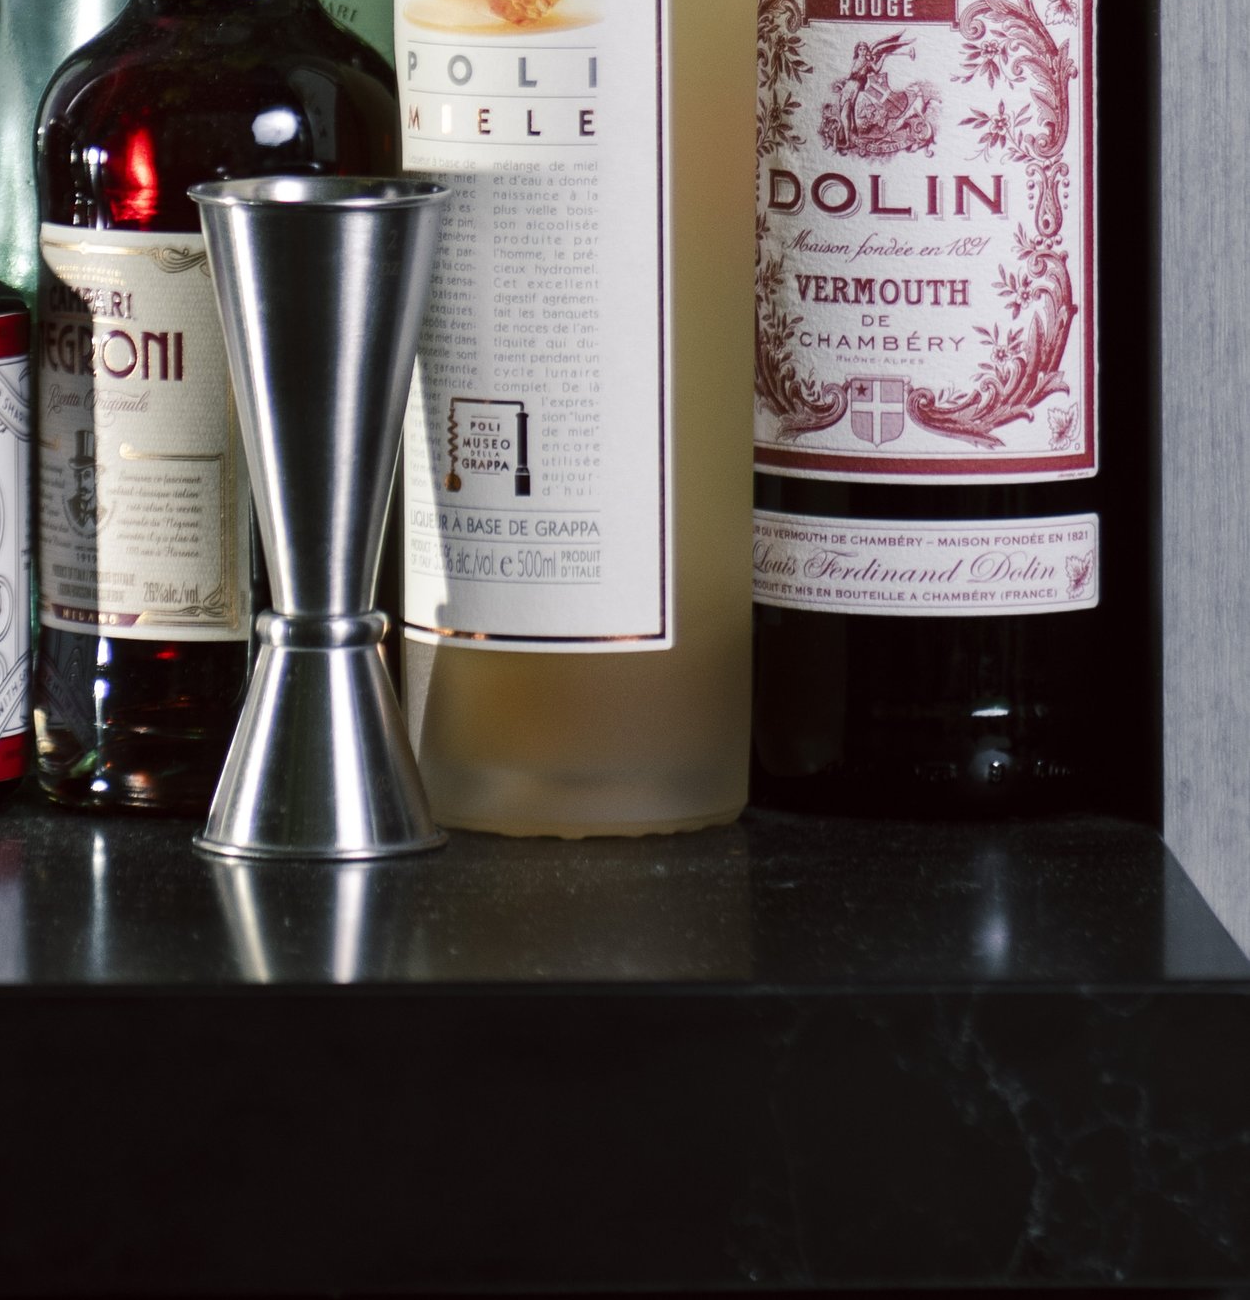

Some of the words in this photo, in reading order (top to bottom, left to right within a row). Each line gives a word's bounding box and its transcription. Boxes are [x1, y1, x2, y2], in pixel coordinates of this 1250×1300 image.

[407, 50, 598, 89] POLI
[407, 102, 596, 137] MIELE
[493, 160, 541, 174] mélange
[549, 160, 565, 172] de
[573, 160, 599, 172] miel
[493, 175, 504, 186] et
[509, 174, 542, 186] d'eau
[559, 174, 599, 187] donné
[493, 190, 559, 201] naissance
[569, 190, 577, 201] à
[586, 190, 599, 201] la
[767, 168, 1008, 222] DOLIN
[493, 204, 518, 217] plus
[525, 204, 558, 216] vielle
[566, 204, 599, 217] bois-
[493, 221, 516, 231] son
[525, 219, 599, 231] alcoolisée
[493, 234, 562, 248] produite
[574, 236, 599, 248] par
[783, 229, 851, 255] Maison
[845, 229, 914, 263] fondée
[919, 245, 943, 257] en
[943, 235, 992, 257] 1821
[493, 249, 546, 261] l'homme,
[554, 249, 566, 260] le
[573, 249, 599, 262] pré-
[493, 264, 526, 275] cieux
[534, 263, 599, 277] hydromel.
[493, 278, 517, 289] Cet
[527, 278, 599, 290] excellent
[794, 273, 972, 308] VERMOUTH
[493, 293, 537, 306] digestif
[542, 293, 599, 306] agrémen-
[518, 307, 535, 319] les
[542, 307, 599, 321] banquets
[861, 313, 891, 329] DE
[493, 322, 510, 334] de
[512, 323, 549, 334] noces
[552, 322, 569, 334] de
[572, 322, 599, 334] l'an-
[493, 337, 536, 350] tiquité
[545, 337, 567, 350] qui
[576, 337, 599, 349] du-
[799, 327, 966, 352] CHAMBÉRY
[493, 352, 526, 364] raient
[530, 352, 581, 366] pendant
[585, 354, 600, 364] un
[835, 353, 925, 366] RHÔNE-ALPES
[493, 367, 534, 380] cycle
[545, 367, 600, 379] lunaire
[561, 382, 579, 394] De
[589, 382, 600, 394] là
[541, 396, 600, 409] l'expres-
[541, 412, 567, 423] sion
[469, 420, 501, 432] POLI
[541, 426, 558, 438] de
[462, 438, 511, 450] MUSEO
[541, 443, 600, 453] encore
[461, 458, 510, 472] GRAPPA
[541, 455, 600, 468] utilisée
[541, 470, 600, 483] aujour-
[410, 510, 448, 532] LIQUEUR
[452, 510, 463, 533] À
[466, 517, 502, 536] BASE
[508, 519, 529, 536] DE
[534, 519, 601, 537] GRAPPA
[762, 527, 772, 537] DU
[773, 528, 828, 544] VERMOUTH
[831, 534, 847, 545] DE
[850, 534, 923, 548] CHAMBÉRY
[937, 536, 990, 548] MAISON
[994, 532, 1045, 547] FONDÉE
[1048, 533, 1063, 544] EN
[1067, 530, 1089, 543] 1821
[560, 550, 601, 563] PRODUIT
[753, 539, 798, 577] Louis
[803, 545, 964, 584] Ferdinand
[966, 549, 1056, 584] Dolin
[517, 550, 557, 578] 500ml
[561, 565, 601, 578] D'ITALIE
[781, 583, 793, 595] ET
[795, 585, 813, 596] MIS
[816, 587, 831, 598] EN
[835, 589, 908, 601] BOUTEILLE
[910, 592, 918, 602] A
[922, 589, 996, 603] CHAMBÉRY
[1000, 588, 1058, 601] (FRANCE)
[62, 607, 118, 625] MILANO
